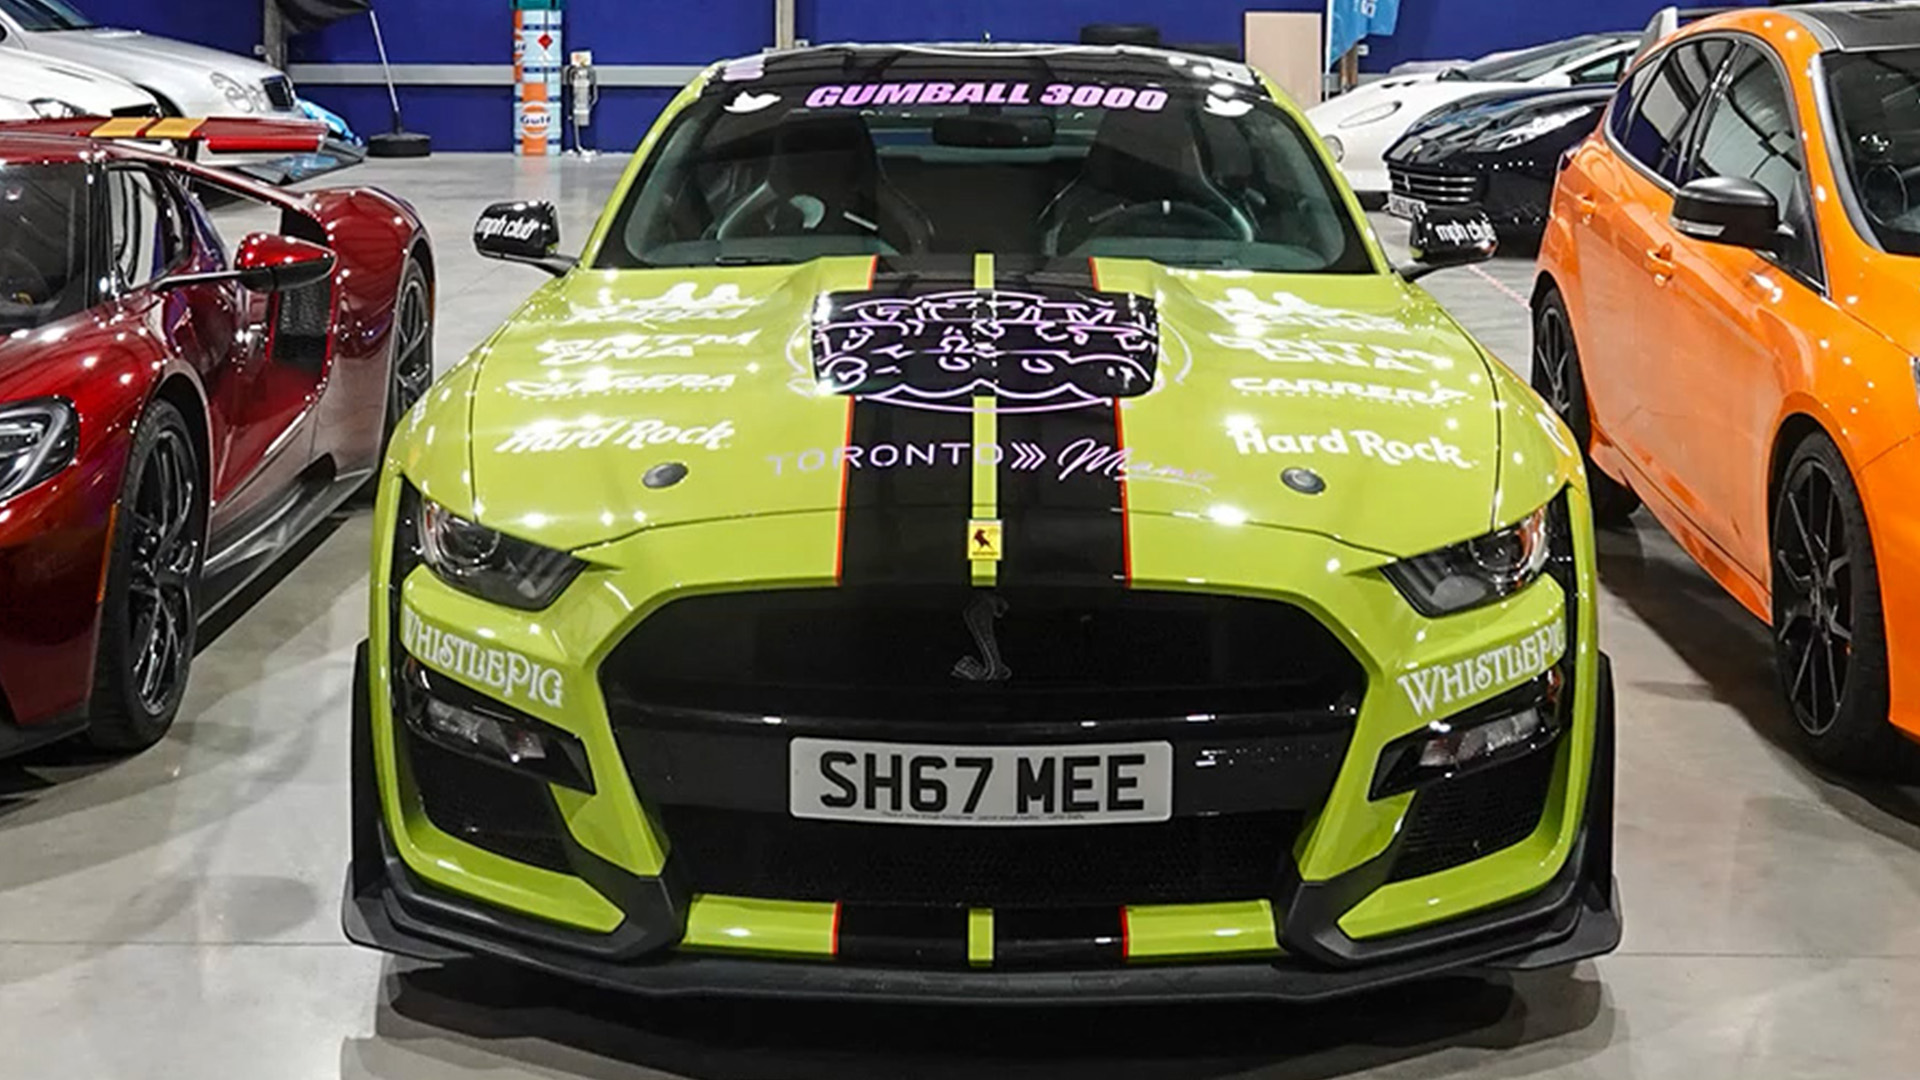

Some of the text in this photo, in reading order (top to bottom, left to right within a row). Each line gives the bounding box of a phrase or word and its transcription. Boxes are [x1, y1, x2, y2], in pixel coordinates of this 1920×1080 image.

[804, 82, 1169, 111] GUMBALL 3000
[520, 114, 551, 125] Gulf
[1435, 220, 1470, 247] mph
[494, 418, 735, 452] Hard Rock
[1226, 422, 1475, 469] Hard Rock
[766, 442, 1002, 476] TORONTO
[820, 750, 1146, 814] SH67 MEE
